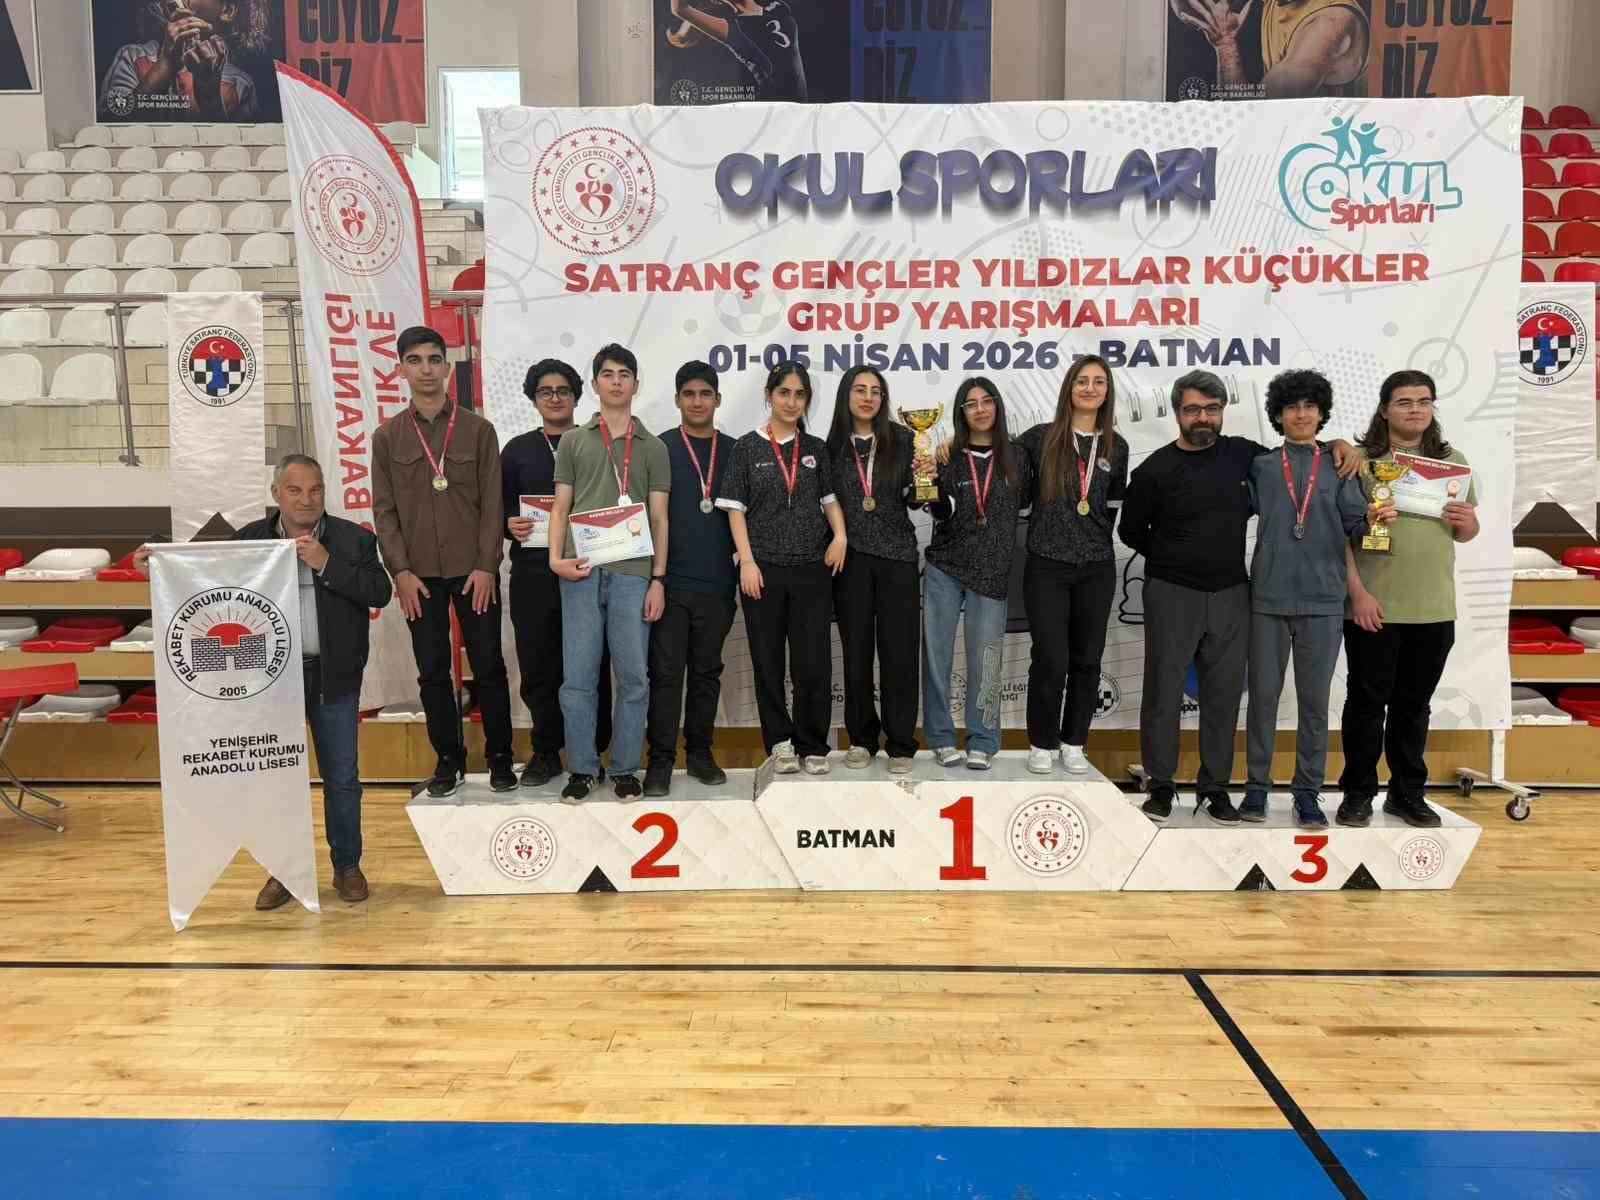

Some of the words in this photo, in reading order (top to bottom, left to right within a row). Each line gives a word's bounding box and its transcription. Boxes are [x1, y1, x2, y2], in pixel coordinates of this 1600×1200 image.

[624, 169, 634, 193] SPOR
[715, 151, 893, 216] OKUL
[896, 147, 1218, 216] SPORLARI
[1303, 161, 1463, 212] OKUL
[563, 261, 760, 299] SATRANÇ
[772, 259, 961, 298] GENÇLER
[972, 255, 1192, 289] YILDIZLAR
[1204, 246, 1430, 292] KÜÇÜKLER
[787, 301, 900, 332] GRUP
[911, 297, 1199, 337] YARIŞMALARI
[1553, 304, 1585, 356] FEDERASYONU
[191, 329, 223, 346] SATRANÇ
[223, 329, 255, 381] FEDERASYONU
[824, 333, 950, 372] NİSAN
[962, 340, 1059, 371] 2026
[1100, 337, 1281, 368] BATMAN
[181, 591, 232, 623] KURUMU
[235, 592, 286, 636] ANADOLU
[170, 623, 197, 682] REKABET
[265, 638, 288, 679] LİSESİ
[219, 685, 248, 697] 2005
[182, 749, 247, 765] REKABET
[249, 743, 305, 759] KURUMU
[209, 733, 279, 749] YENİŞEHİR
[190, 760, 255, 777] ANADOLU
[259, 757, 300, 770] LİSESİ
[631, 812, 680, 879] 2
[796, 829, 896, 849] BATMAN
[939, 796, 988, 881] 1
[1289, 834, 1329, 884] 3
